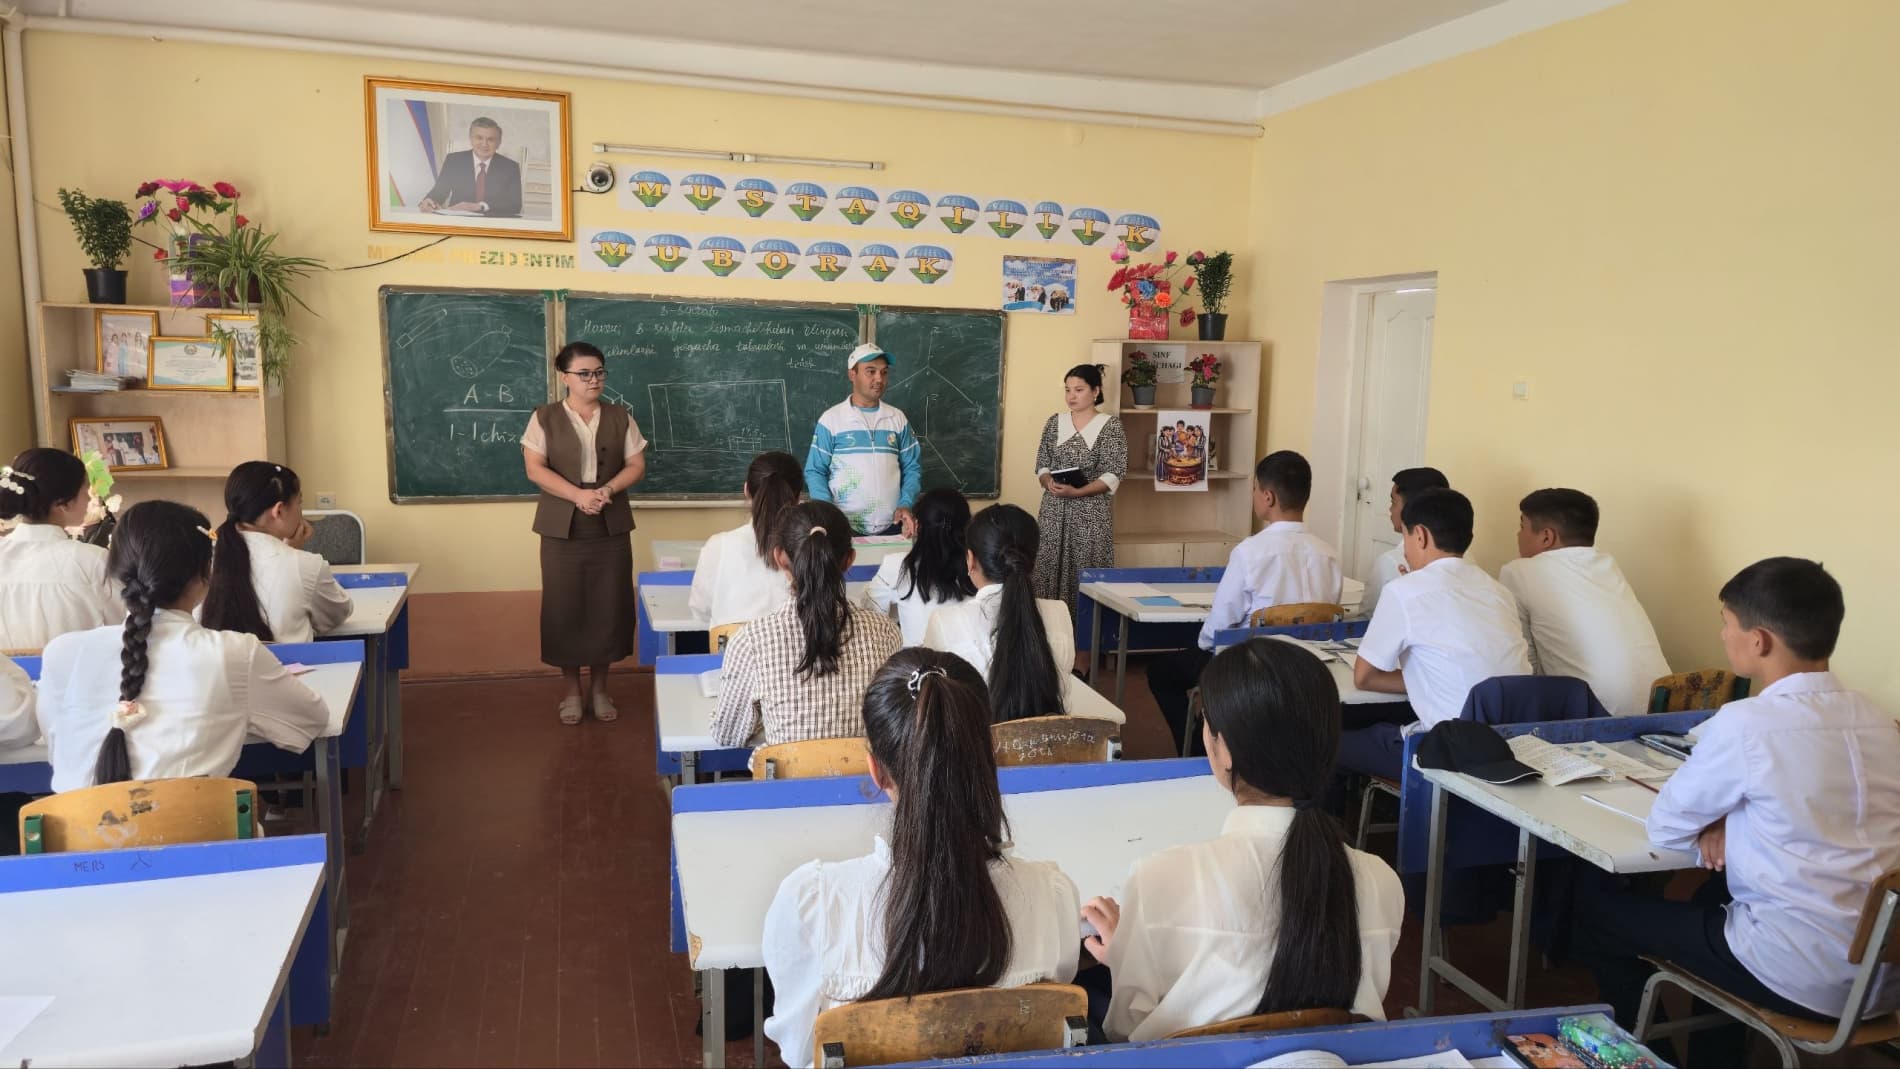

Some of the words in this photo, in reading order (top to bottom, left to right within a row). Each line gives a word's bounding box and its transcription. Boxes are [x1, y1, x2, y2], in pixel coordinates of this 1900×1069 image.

[637, 180, 1150, 246] MUSTAQILLIK
[599, 241, 941, 275] MUBORAK
[1152, 351, 1172, 359] SINF
